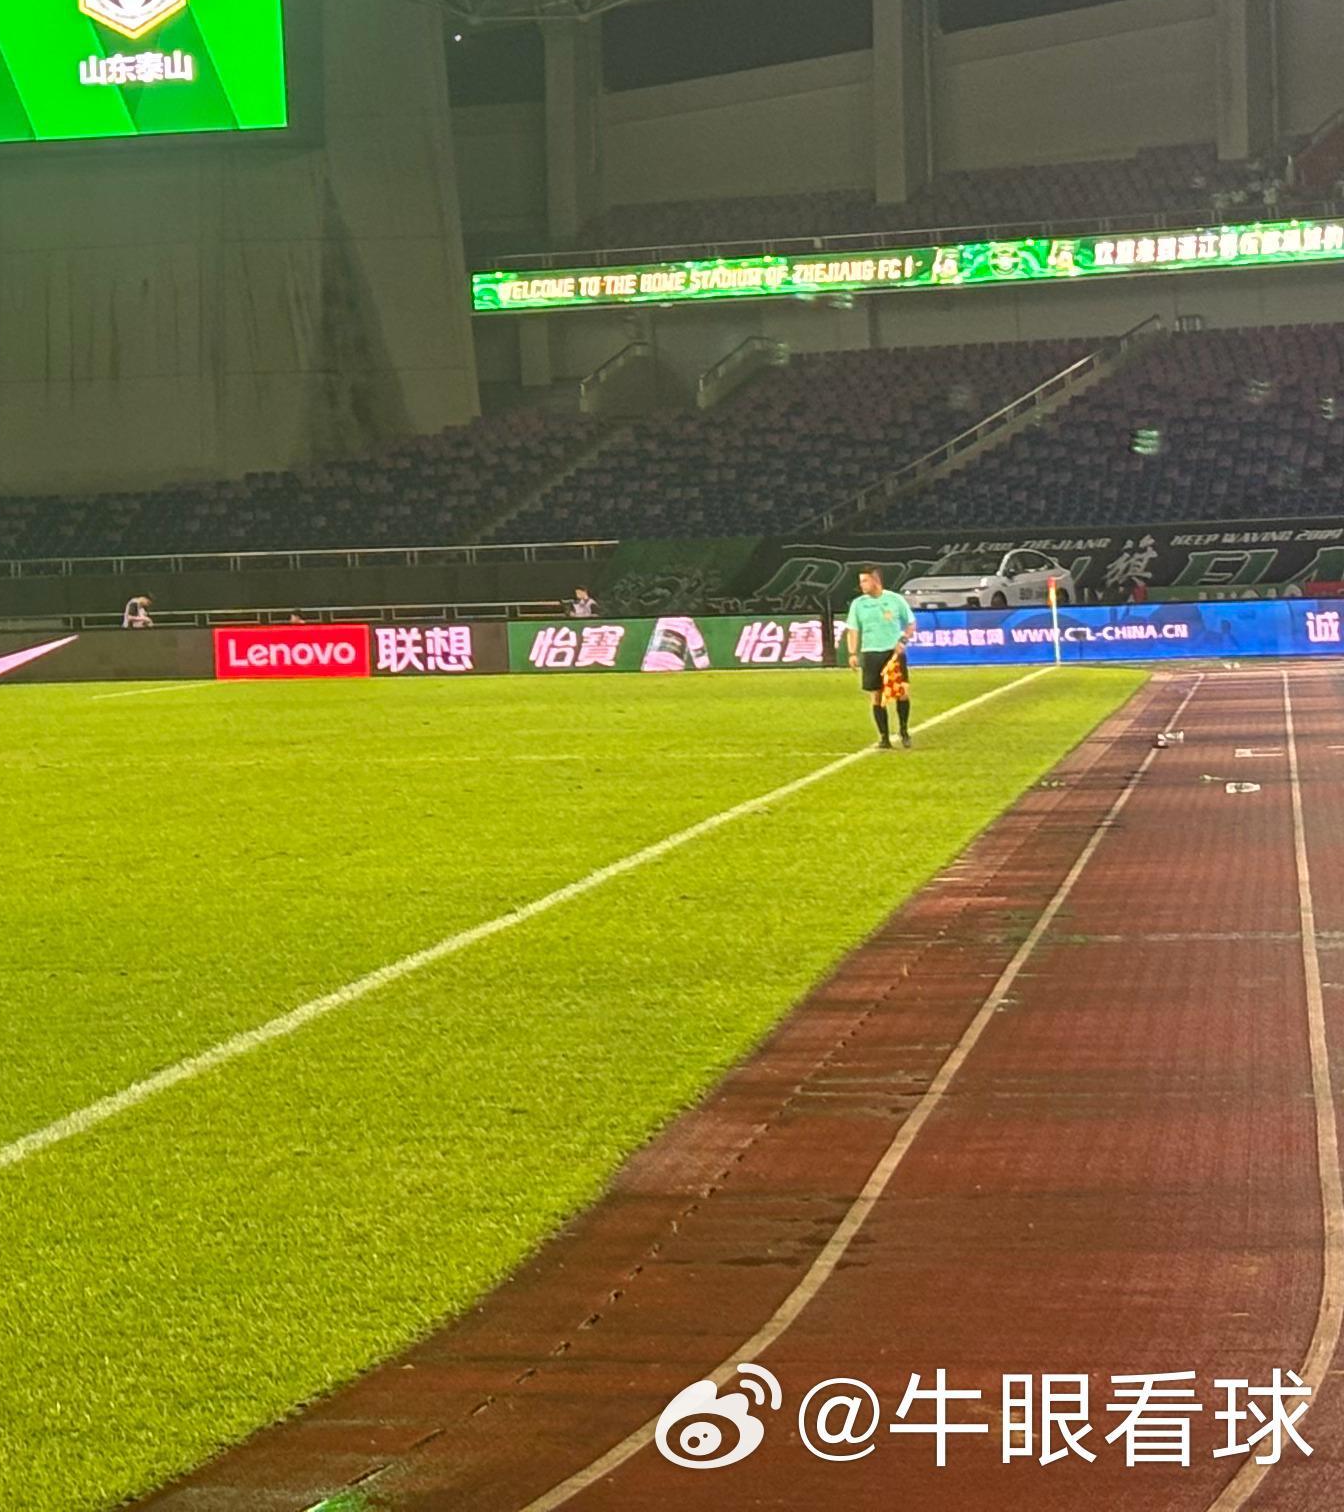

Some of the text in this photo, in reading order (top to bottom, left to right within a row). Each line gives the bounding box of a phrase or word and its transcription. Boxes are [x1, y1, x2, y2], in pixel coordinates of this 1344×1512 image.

[79, 50, 193, 84] 山东泰山
[498, 278, 575, 301] WELCOME
[579, 276, 602, 297] TO
[604, 274, 637, 295] THE
[640, 273, 685, 293] HOME
[690, 267, 764, 290] STADIUM
[791, 262, 874, 284] ZHEJIANG
[1020, 537, 1112, 550] ZHEJIANG
[1170, 534, 1220, 546] KEEP
[1222, 530, 1294, 544] WAVING
[227, 629, 356, 668] Lenovo
[376, 625, 475, 673] 联想
